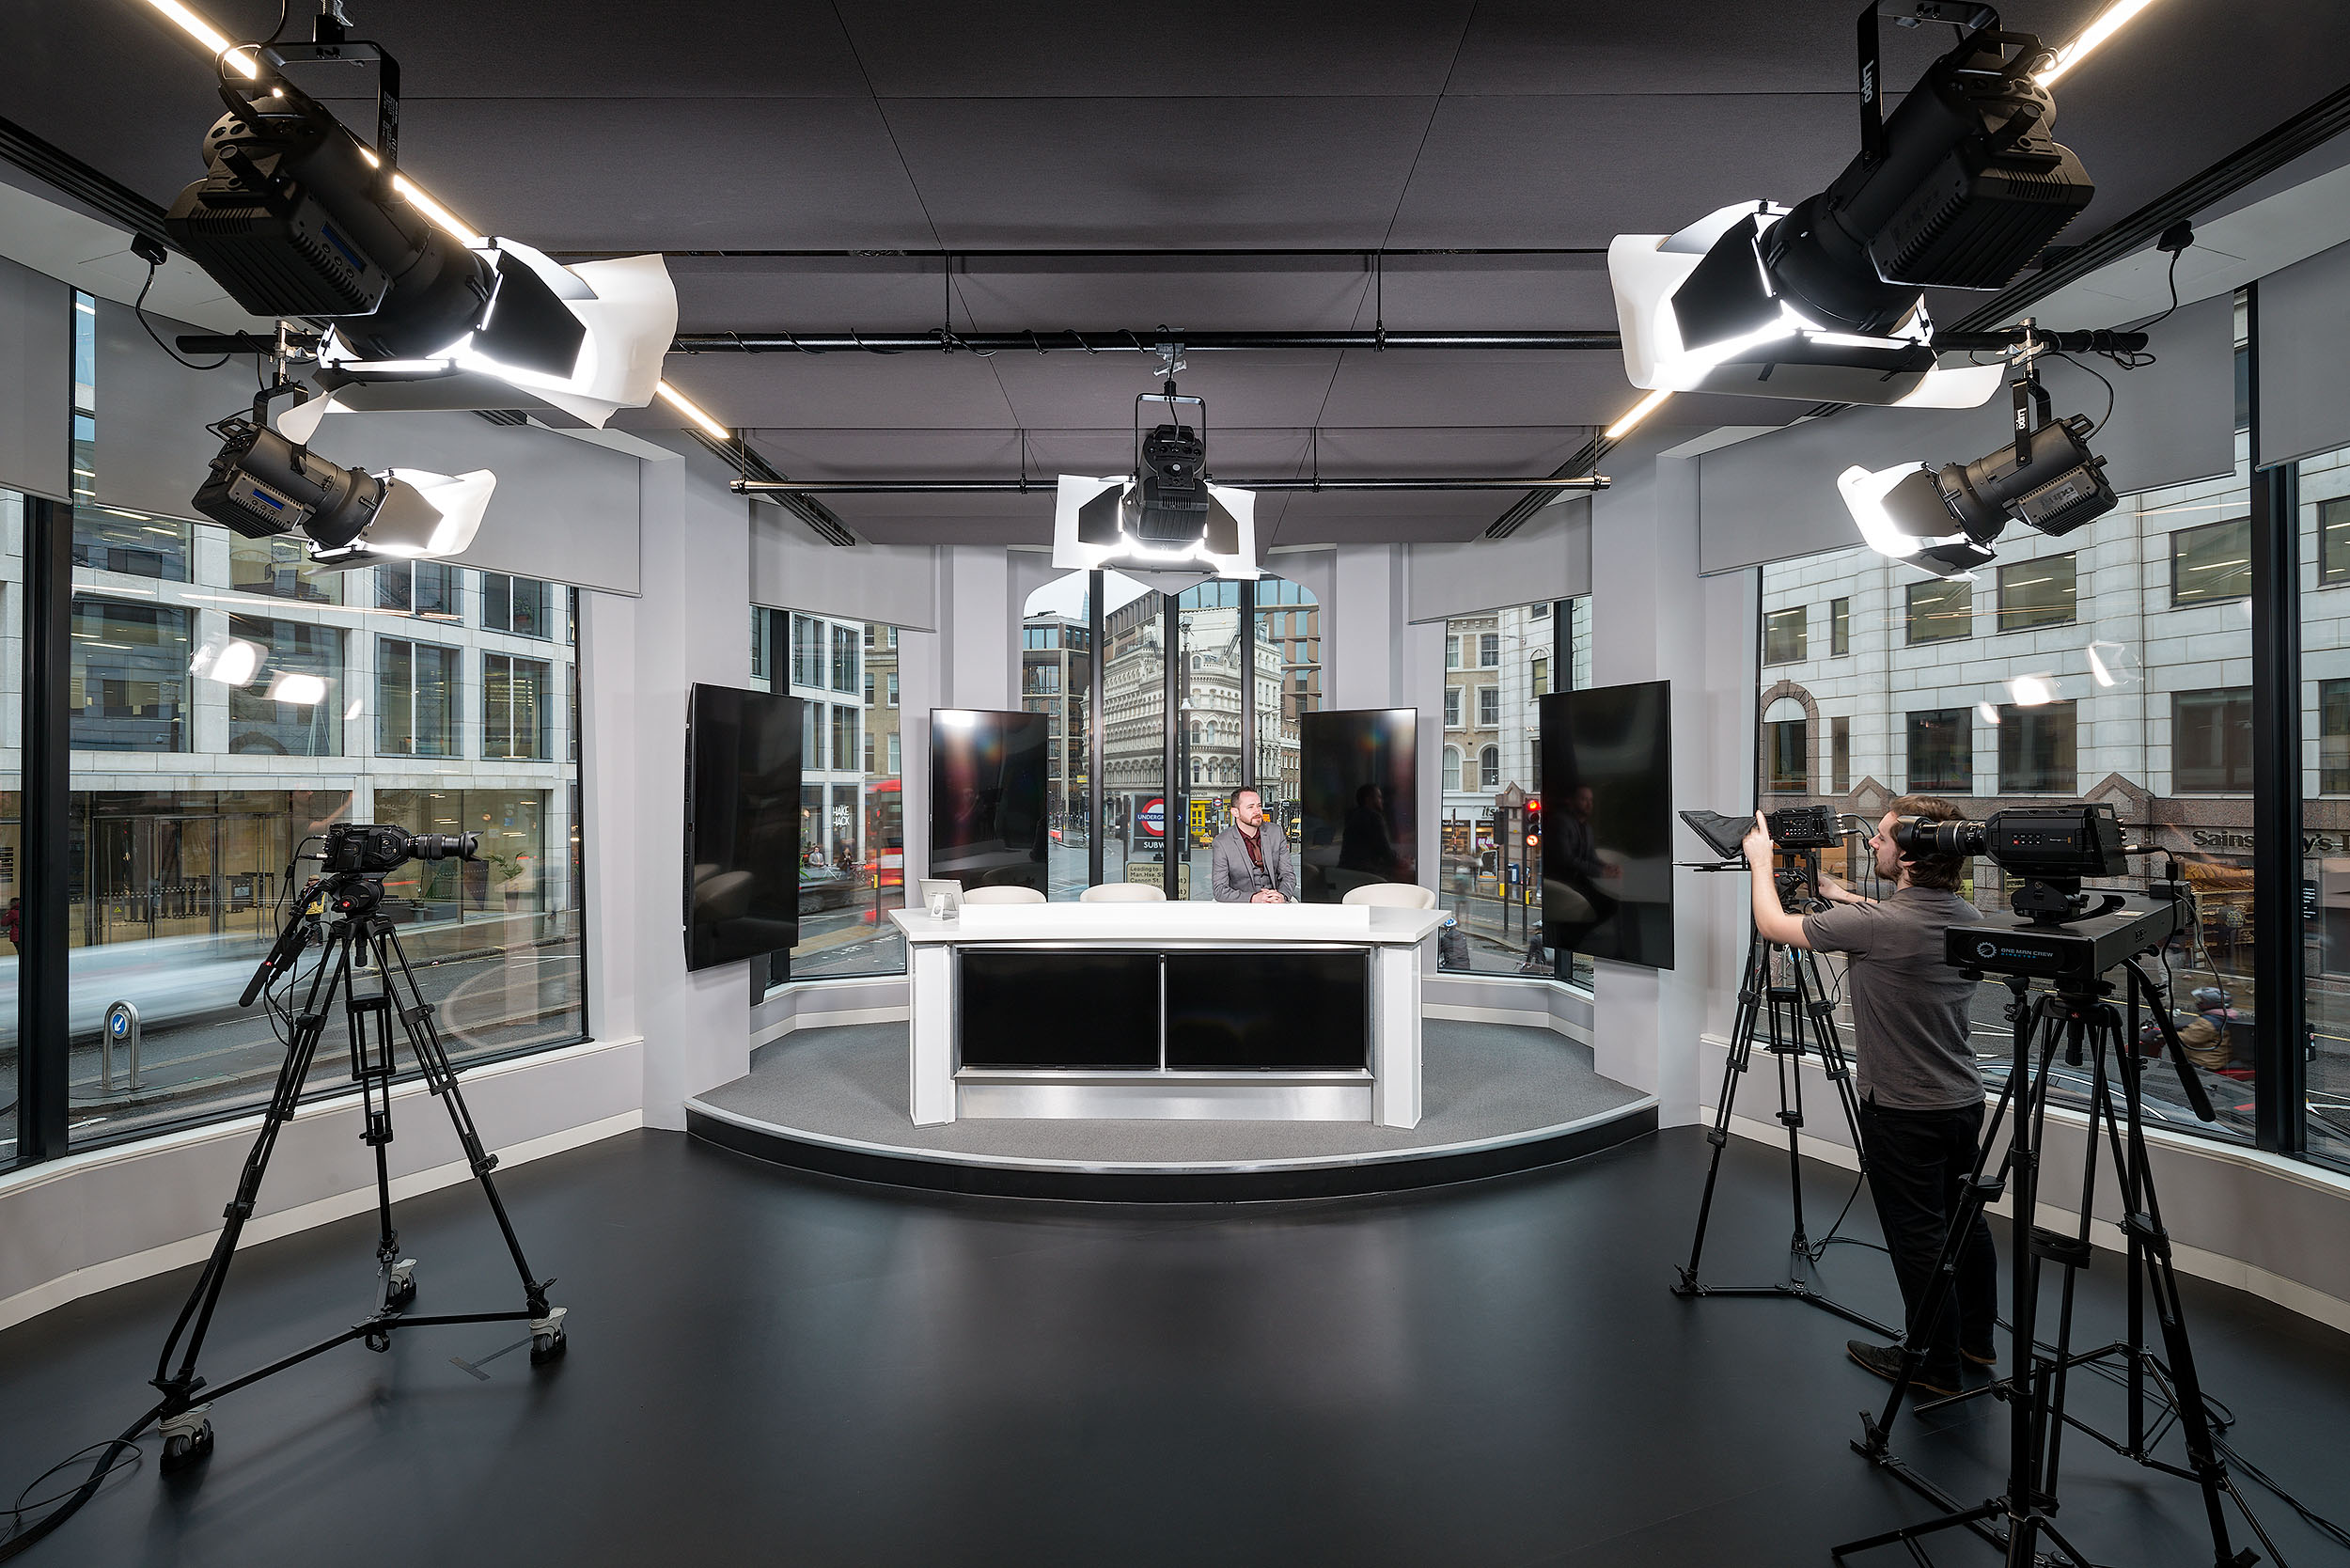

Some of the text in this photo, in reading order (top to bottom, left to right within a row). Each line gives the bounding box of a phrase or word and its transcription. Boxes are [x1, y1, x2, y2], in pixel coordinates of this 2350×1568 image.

[1861, 59, 1872, 103] Lupo
[2015, 407, 2027, 430] Lupo
[833, 806, 849, 815] HAKE
[1482, 806, 1497, 816] its
[833, 816, 850, 826] HACK
